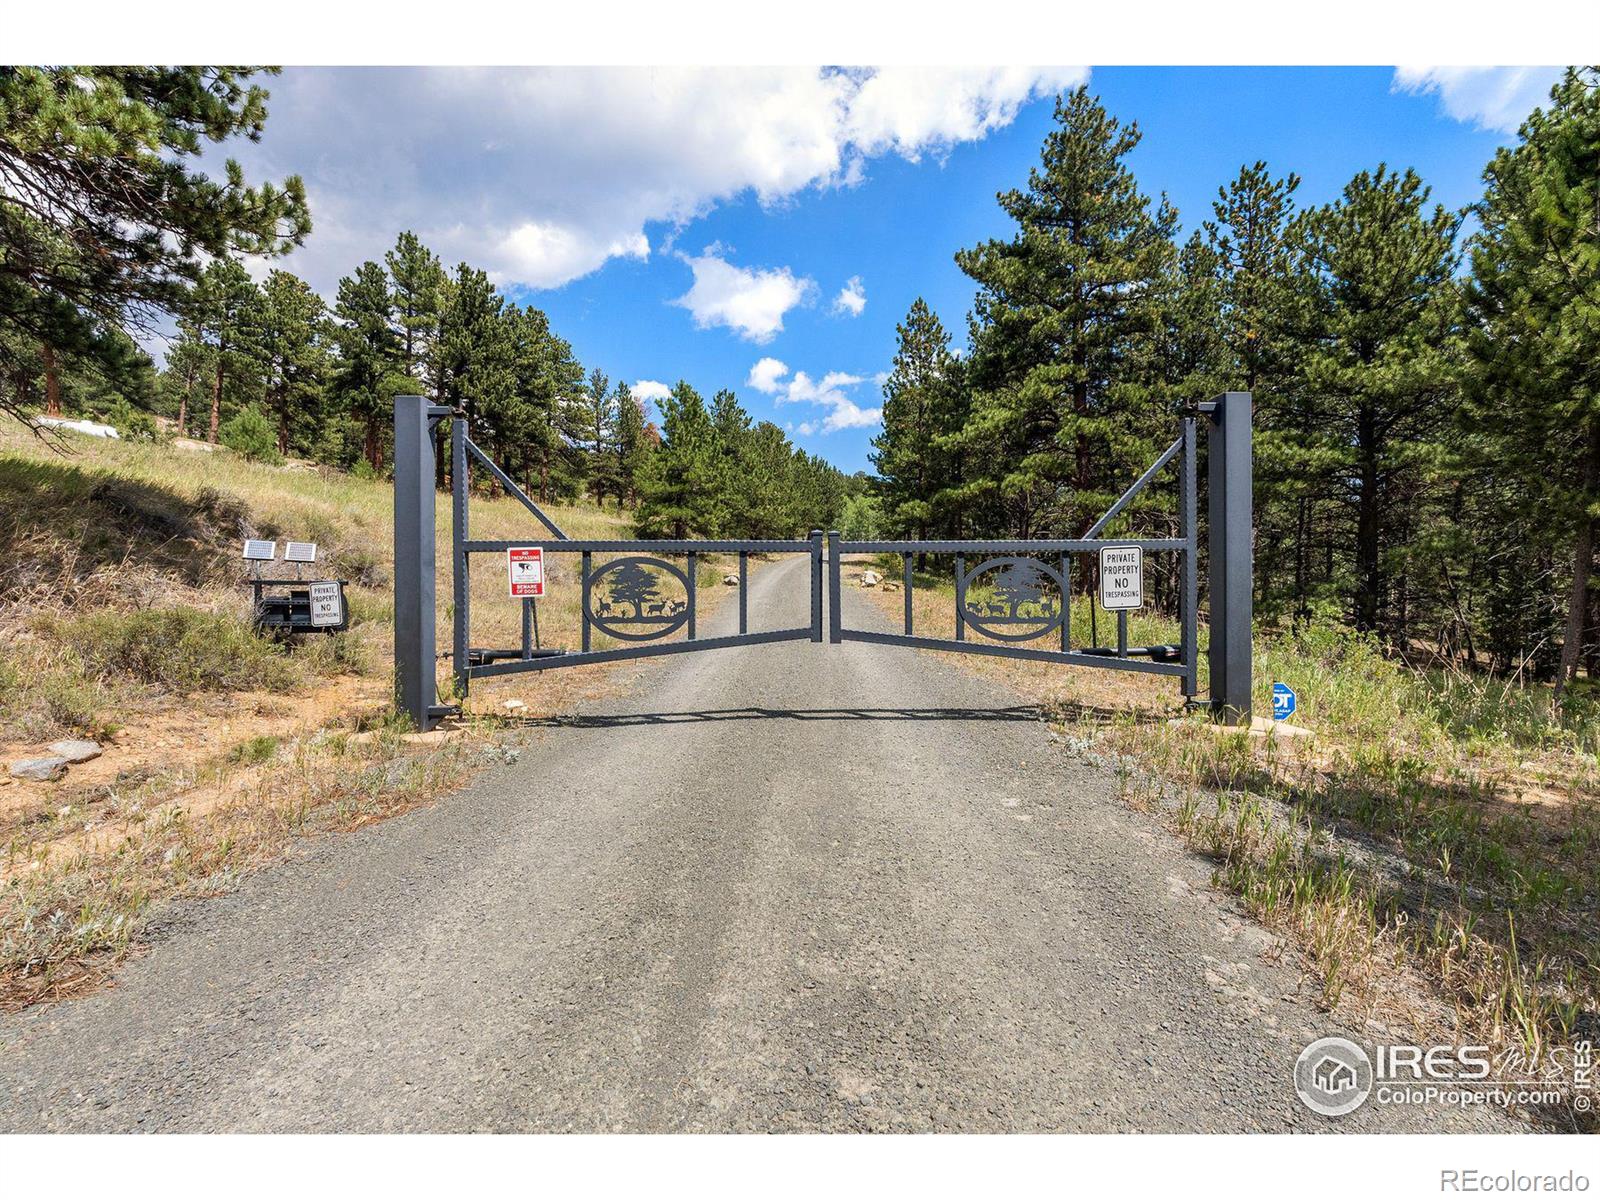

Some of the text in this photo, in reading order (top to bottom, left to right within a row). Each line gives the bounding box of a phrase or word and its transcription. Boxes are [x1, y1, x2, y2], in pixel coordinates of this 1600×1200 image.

[1107, 553, 1136, 563] PRIVATE
[1104, 565, 1139, 575] PROPERTY
[1115, 577, 1129, 588] NO
[312, 594, 337, 603] PROPERTY
[1105, 590, 1139, 598] TRESPASSING
